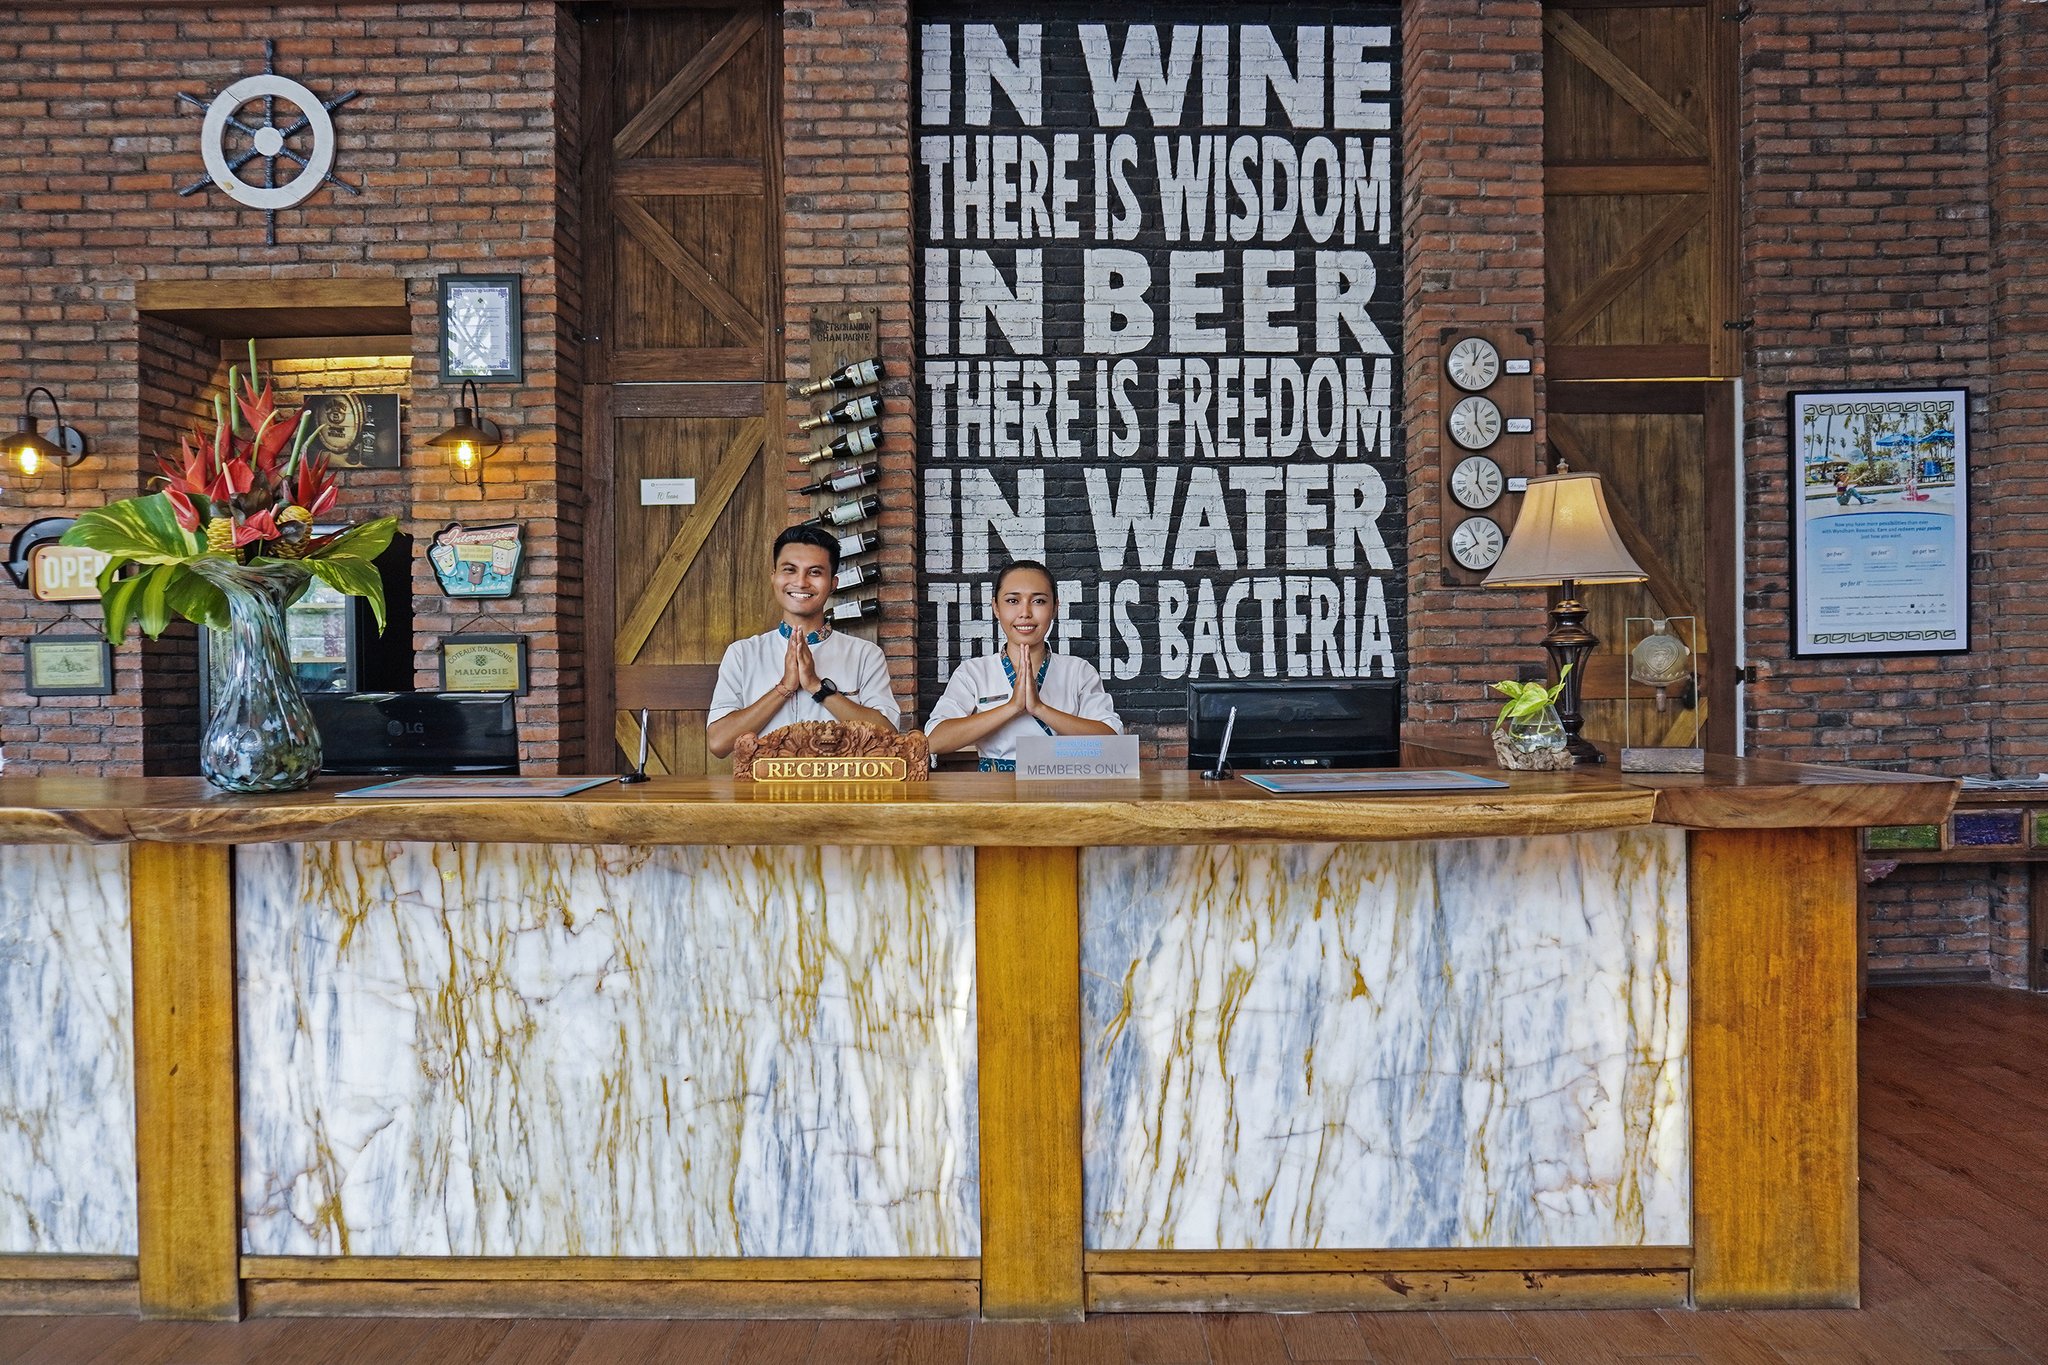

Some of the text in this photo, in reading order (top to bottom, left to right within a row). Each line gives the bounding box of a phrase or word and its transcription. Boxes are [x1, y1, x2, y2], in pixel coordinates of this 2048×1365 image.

[921, 23, 1392, 129] IN WINE
[920, 133, 1391, 244] THERE IS WISDOM
[924, 248, 1394, 355] IN BEER
[817, 333, 870, 341] CHAMPAGNE
[925, 359, 1081, 458] THERE
[1097, 358, 1141, 458] IS
[1157, 358, 1392, 459] FREEDOM
[924, 468, 1046, 573] IN
[1083, 463, 1393, 571] WATER
[442, 528, 515, 545] Intermission
[928, 575, 1396, 683] THE IS BACTERIA
[448, 645, 514, 664] COTEAUX D'ANCENIS
[454, 668, 509, 676] MALVOISIE
[406, 723, 424, 734] LG
[767, 762, 895, 778] RECEPTION
[1027, 763, 1129, 775] MEMBERS ONLY
